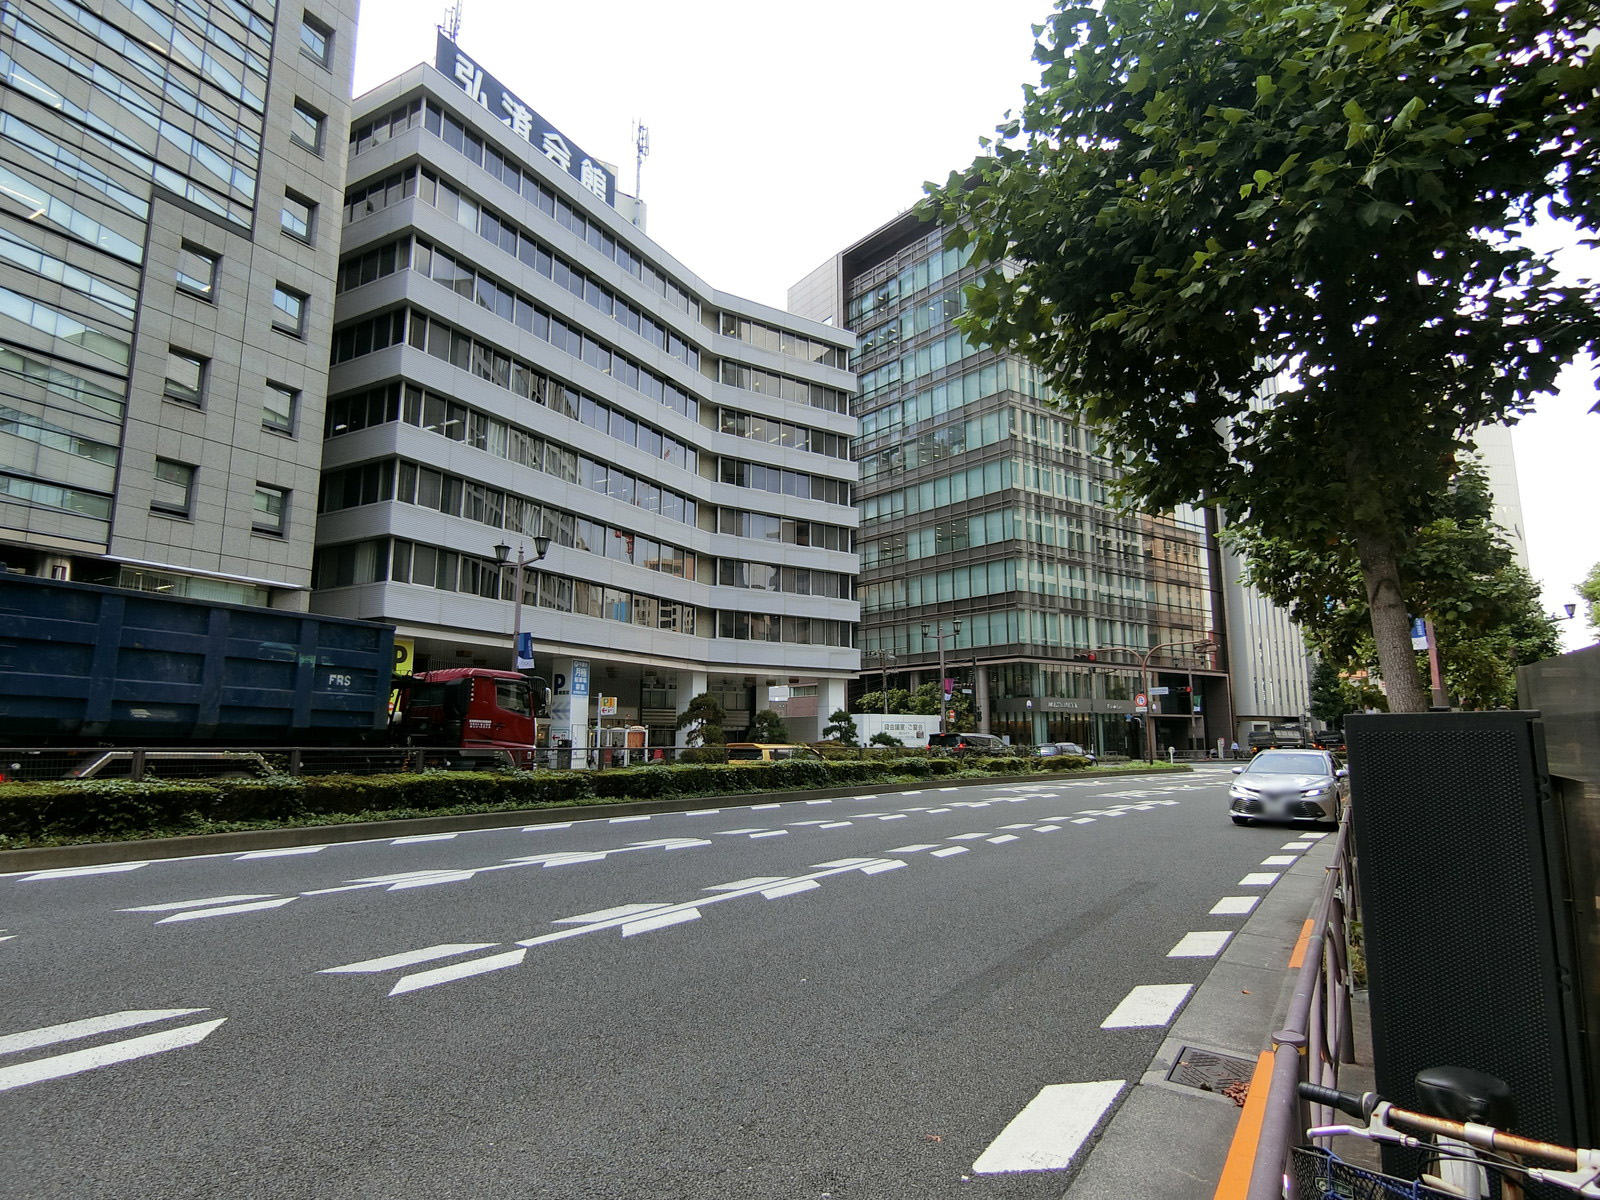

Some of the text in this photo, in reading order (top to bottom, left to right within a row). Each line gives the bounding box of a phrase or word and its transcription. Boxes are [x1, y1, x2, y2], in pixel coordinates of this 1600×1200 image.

[454, 53, 607, 203] 弘済会館
[393, 645, 408, 671] P
[328, 673, 352, 687] FRS
[554, 674, 566, 695] P
